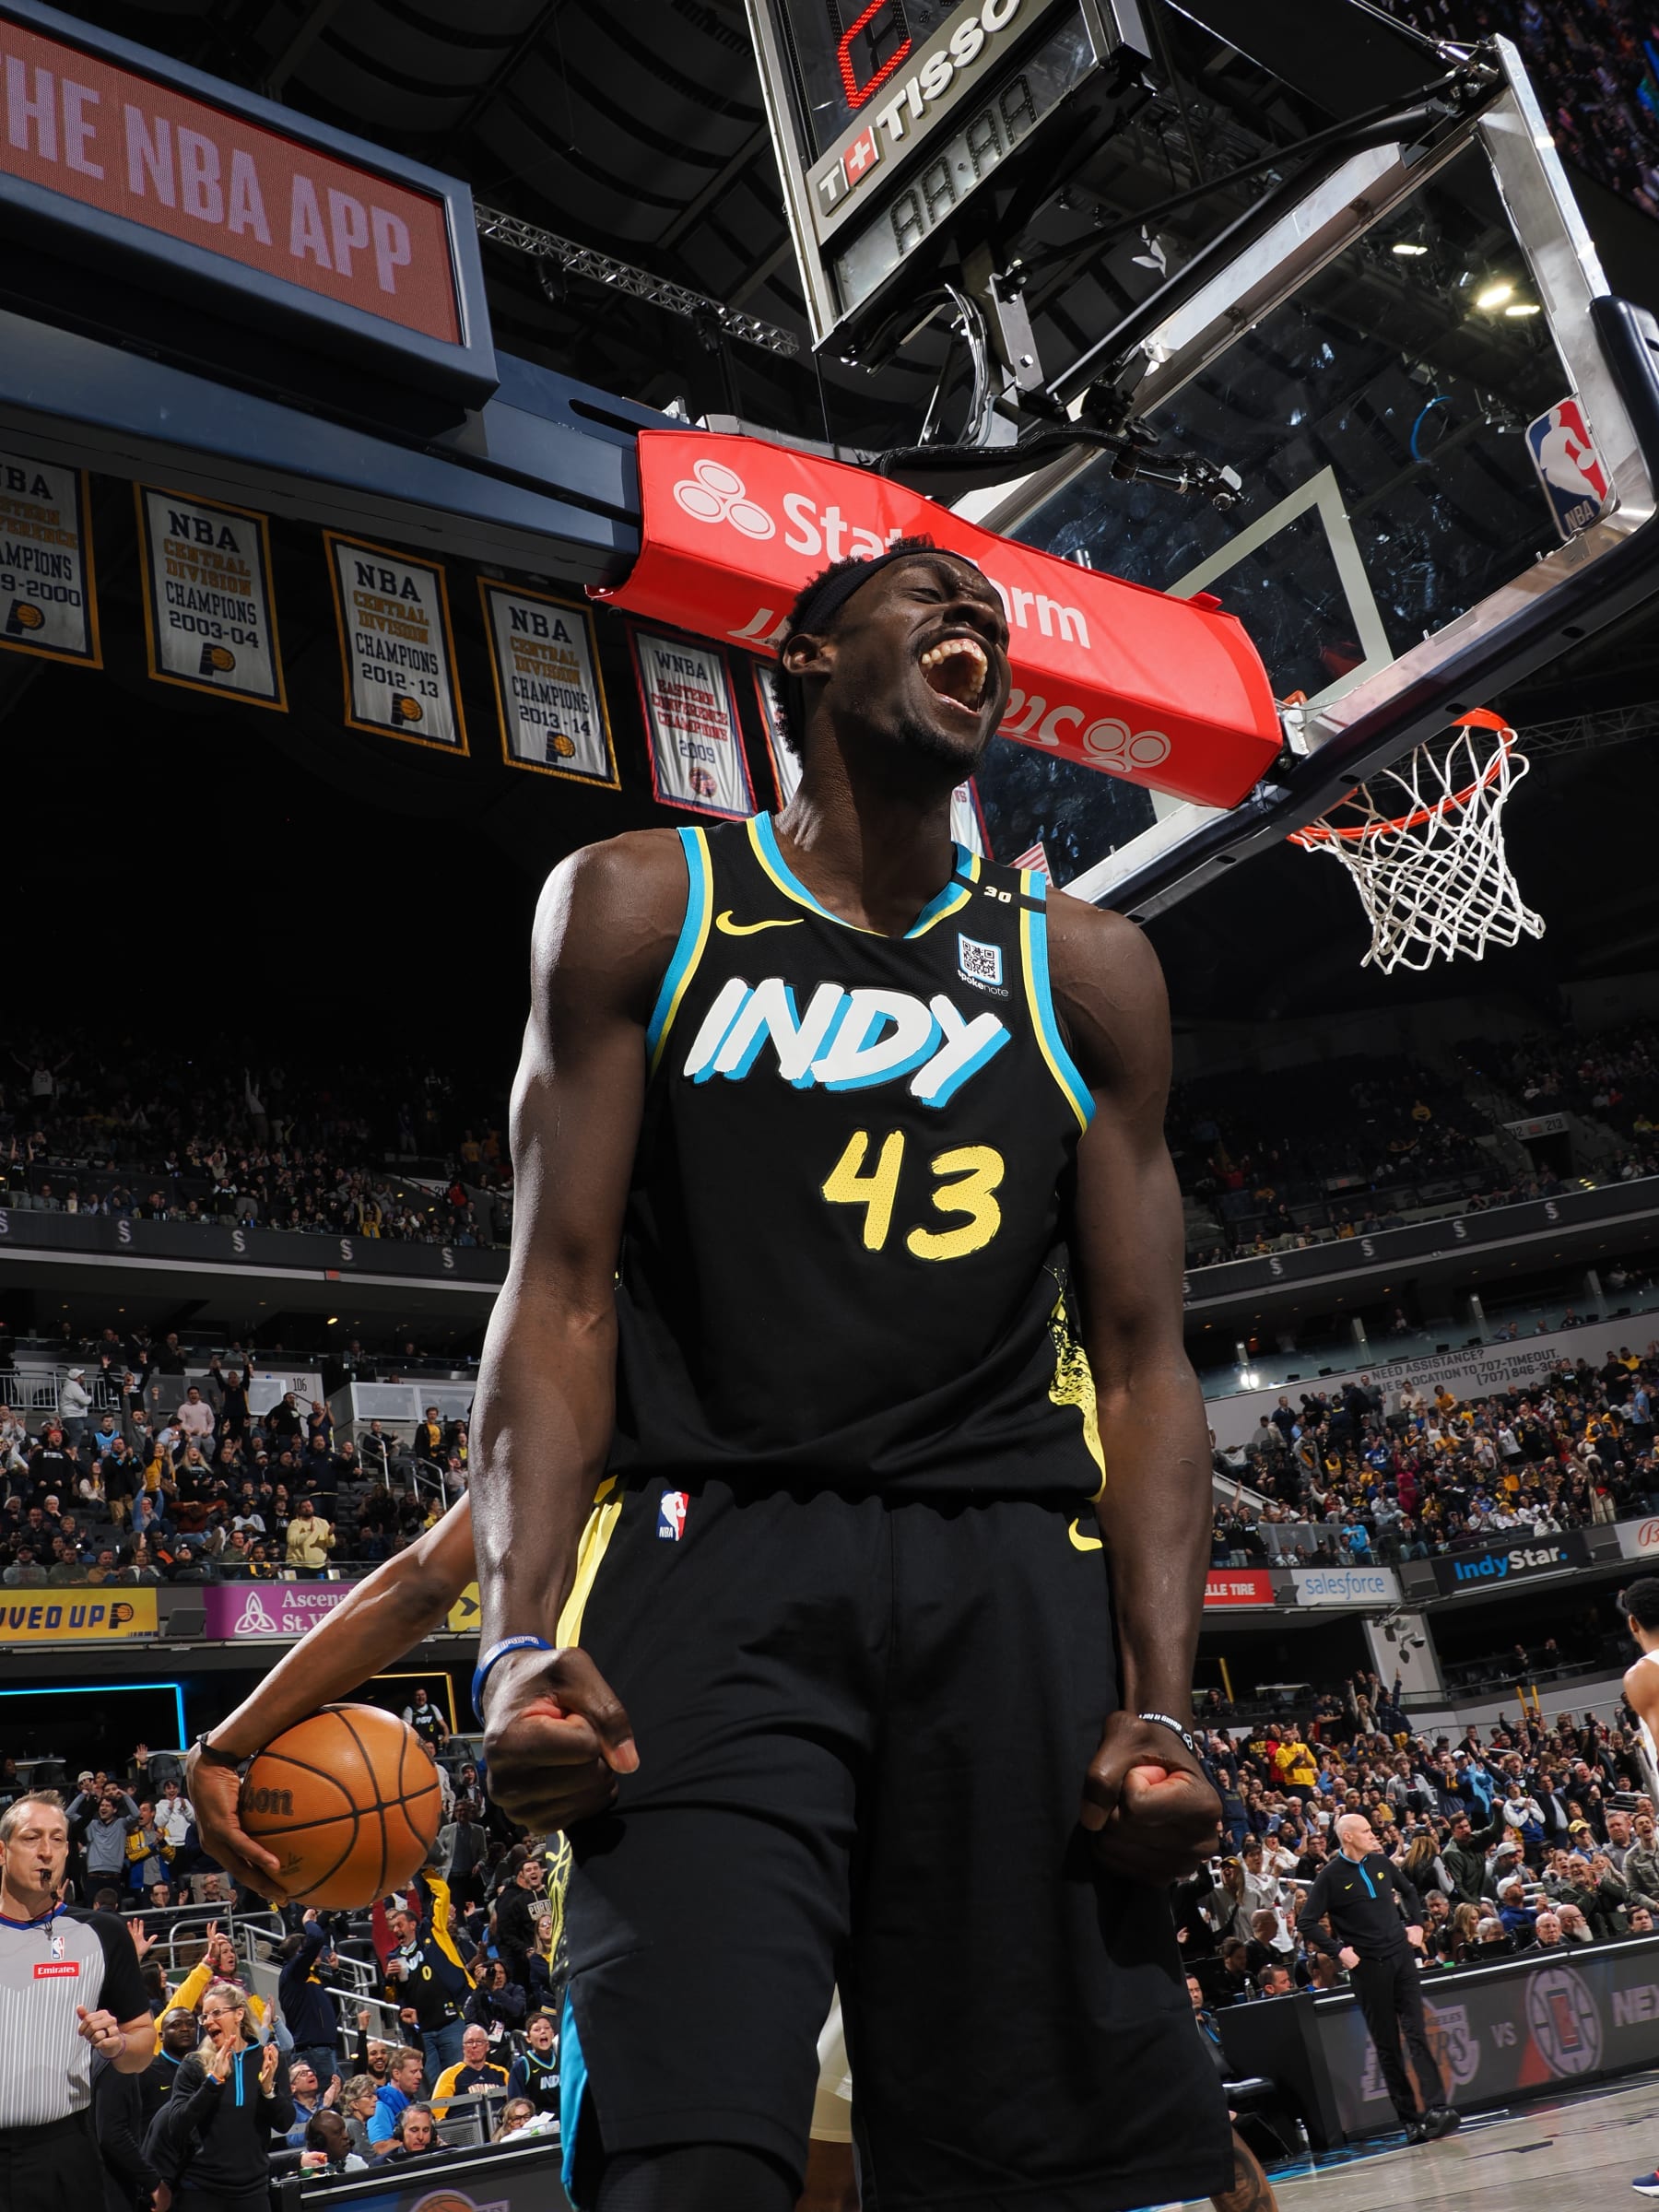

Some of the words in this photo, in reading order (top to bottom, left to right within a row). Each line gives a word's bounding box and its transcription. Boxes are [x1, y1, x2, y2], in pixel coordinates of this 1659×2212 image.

[124, 103, 272, 246] NBA
[290, 172, 411, 295] APP
[0, 465, 53, 500] BA
[168, 510, 240, 553] NBA
[783, 493, 902, 563] Sta
[1564, 500, 1594, 532] NBA
[164, 538, 251, 577] CENTRAL
[165, 558, 252, 596] DIVISION
[355, 560, 421, 603] NBA
[166, 581, 257, 625] CHAMPIONS
[353, 590, 429, 627] CENTRAL
[170, 610, 258, 648] 2003-04
[358, 609, 429, 644] DIVISION
[509, 606, 572, 644] NBA
[356, 632, 439, 676] CHAMPIONS
[510, 636, 580, 668] CENTRAL
[654, 650, 708, 680] WNBA
[514, 654, 581, 686] DIVISION
[512, 676, 589, 713] CHAMPIONS
[656, 679, 714, 706] EASTERN
[651, 693, 728, 726] CONFERENCE
[657, 712, 728, 741] CHAMPIONS
[679, 739, 715, 764] 2009
[983, 886, 1012, 903] 30
[957, 969, 1009, 997] spokenote
[683, 978, 1011, 1108] INDY
[1546, 1118, 1563, 1130] 213
[822, 1129, 1005, 1261] 43
[1371, 1366, 1403, 1381] NEED
[1406, 1348, 1484, 1373] ASSISTANCE?
[1411, 1369, 1462, 1386] OCATION
[1462, 1364, 1477, 1376] TO
[293, 1377, 307, 1392] 106
[659, 1526, 674, 1538] NBA
[282, 1589, 353, 1608] Ascens
[1230, 1583, 1255, 1596] TIRE
[1305, 1572, 1385, 1600] salesforce
[69, 1605, 105, 1629] UP
[282, 1614, 309, 1632] St.
[38, 1966, 76, 1975] Emirates
[421, 1965, 432, 1981] 0
[540, 2074, 561, 2090] IND
